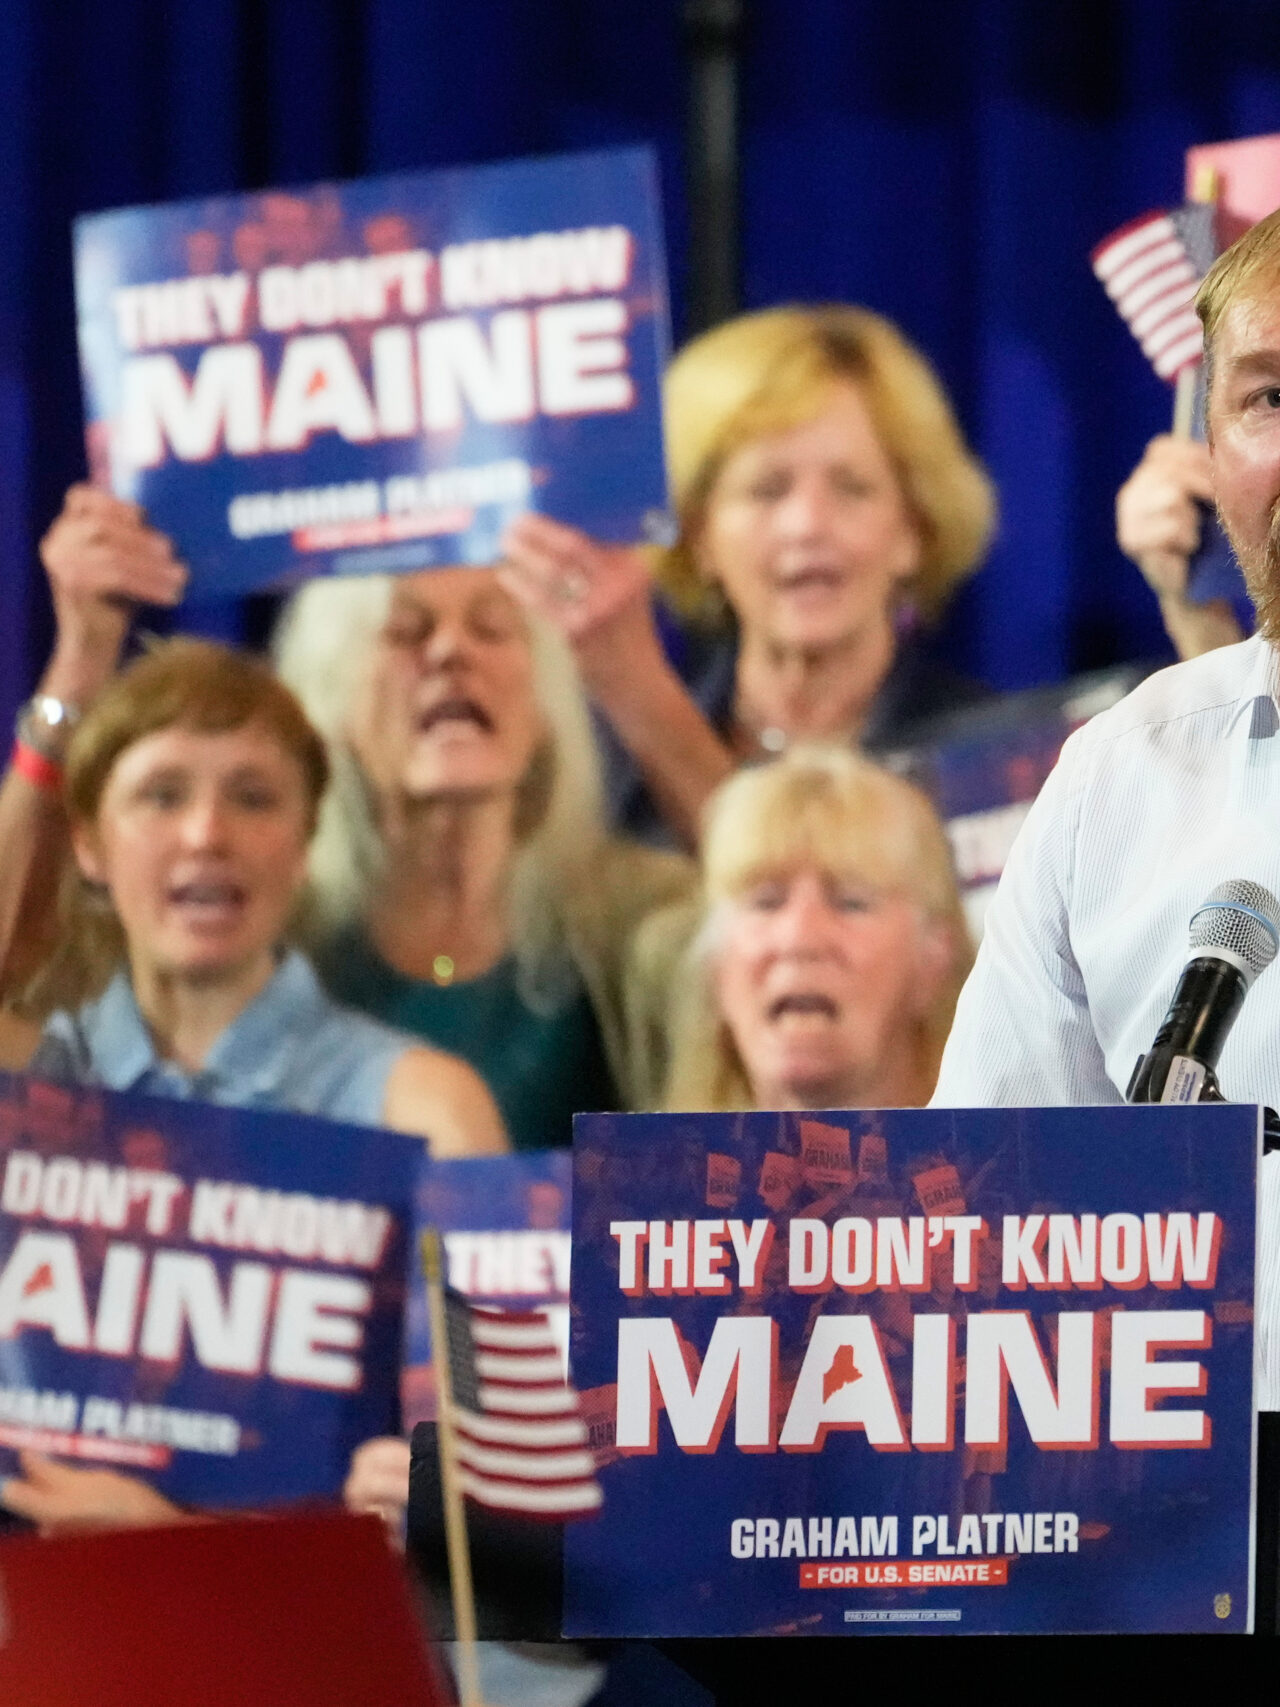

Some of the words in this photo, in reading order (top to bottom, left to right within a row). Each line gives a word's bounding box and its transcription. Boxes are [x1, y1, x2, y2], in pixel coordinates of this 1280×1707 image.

[115, 299, 635, 470] MAINE
[1, 1148, 183, 1238] DON'T
[191, 1177, 391, 1270] KNOW
[610, 1219, 772, 1295] THEY
[788, 1214, 988, 1291] DON'T
[1002, 1211, 1221, 1290] KNOW
[0, 1229, 371, 1391] AINE
[616, 1310, 1211, 1453] MAINE
[731, 1515, 898, 1559] GRAHAM
[911, 1512, 1079, 1556] PLATNER
[817, 1566, 859, 1585] FOR
[865, 1564, 903, 1584] U.S.
[908, 1563, 990, 1583] SENATE
